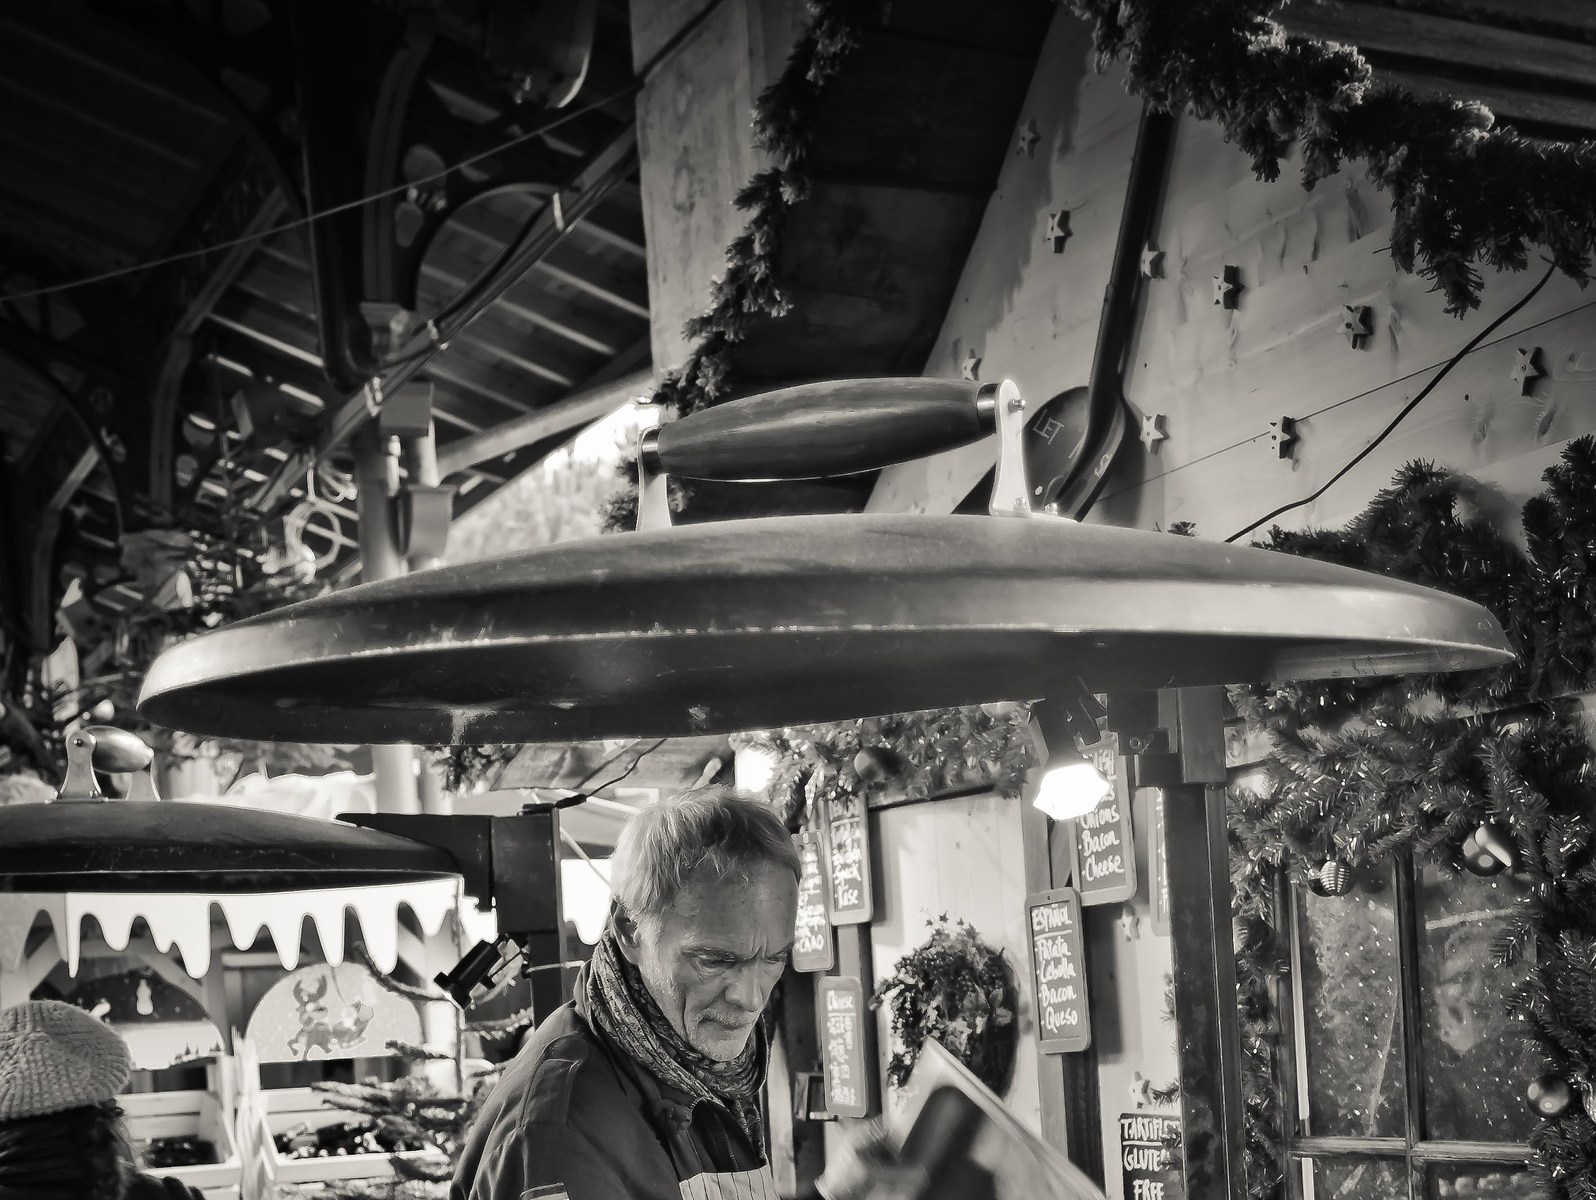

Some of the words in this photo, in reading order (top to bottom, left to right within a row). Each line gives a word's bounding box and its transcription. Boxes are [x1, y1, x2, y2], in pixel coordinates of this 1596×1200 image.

[1081, 829, 1120, 857] Bacon
[1084, 854, 1124, 882] Cheese
[1041, 983, 1077, 1008] Bacon
[1045, 1006, 1078, 1033] Queso
